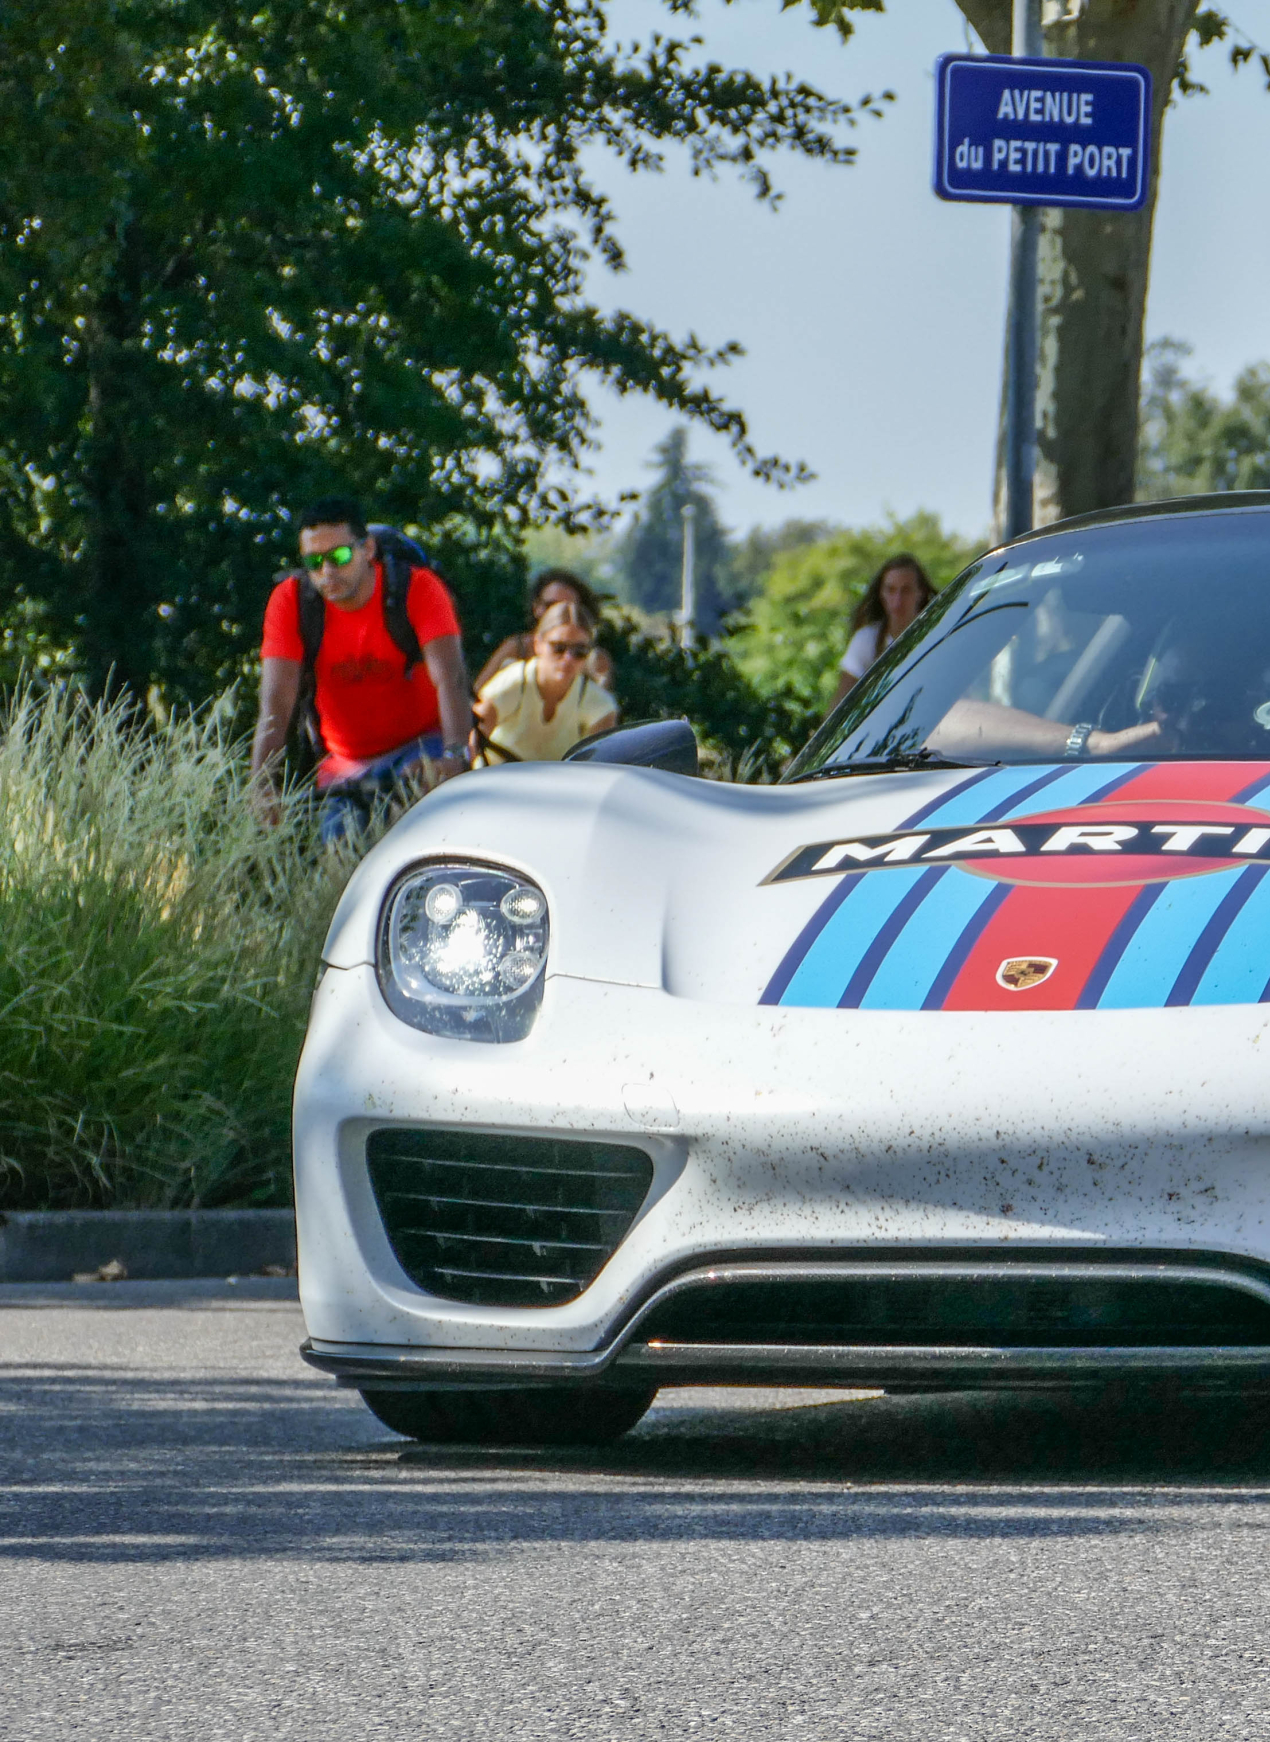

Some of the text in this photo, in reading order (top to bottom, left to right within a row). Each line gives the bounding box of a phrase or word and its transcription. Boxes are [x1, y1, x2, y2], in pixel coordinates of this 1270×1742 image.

[996, 88, 1094, 125] AVENUE
[955, 137, 1132, 178] du PETIT PORT
